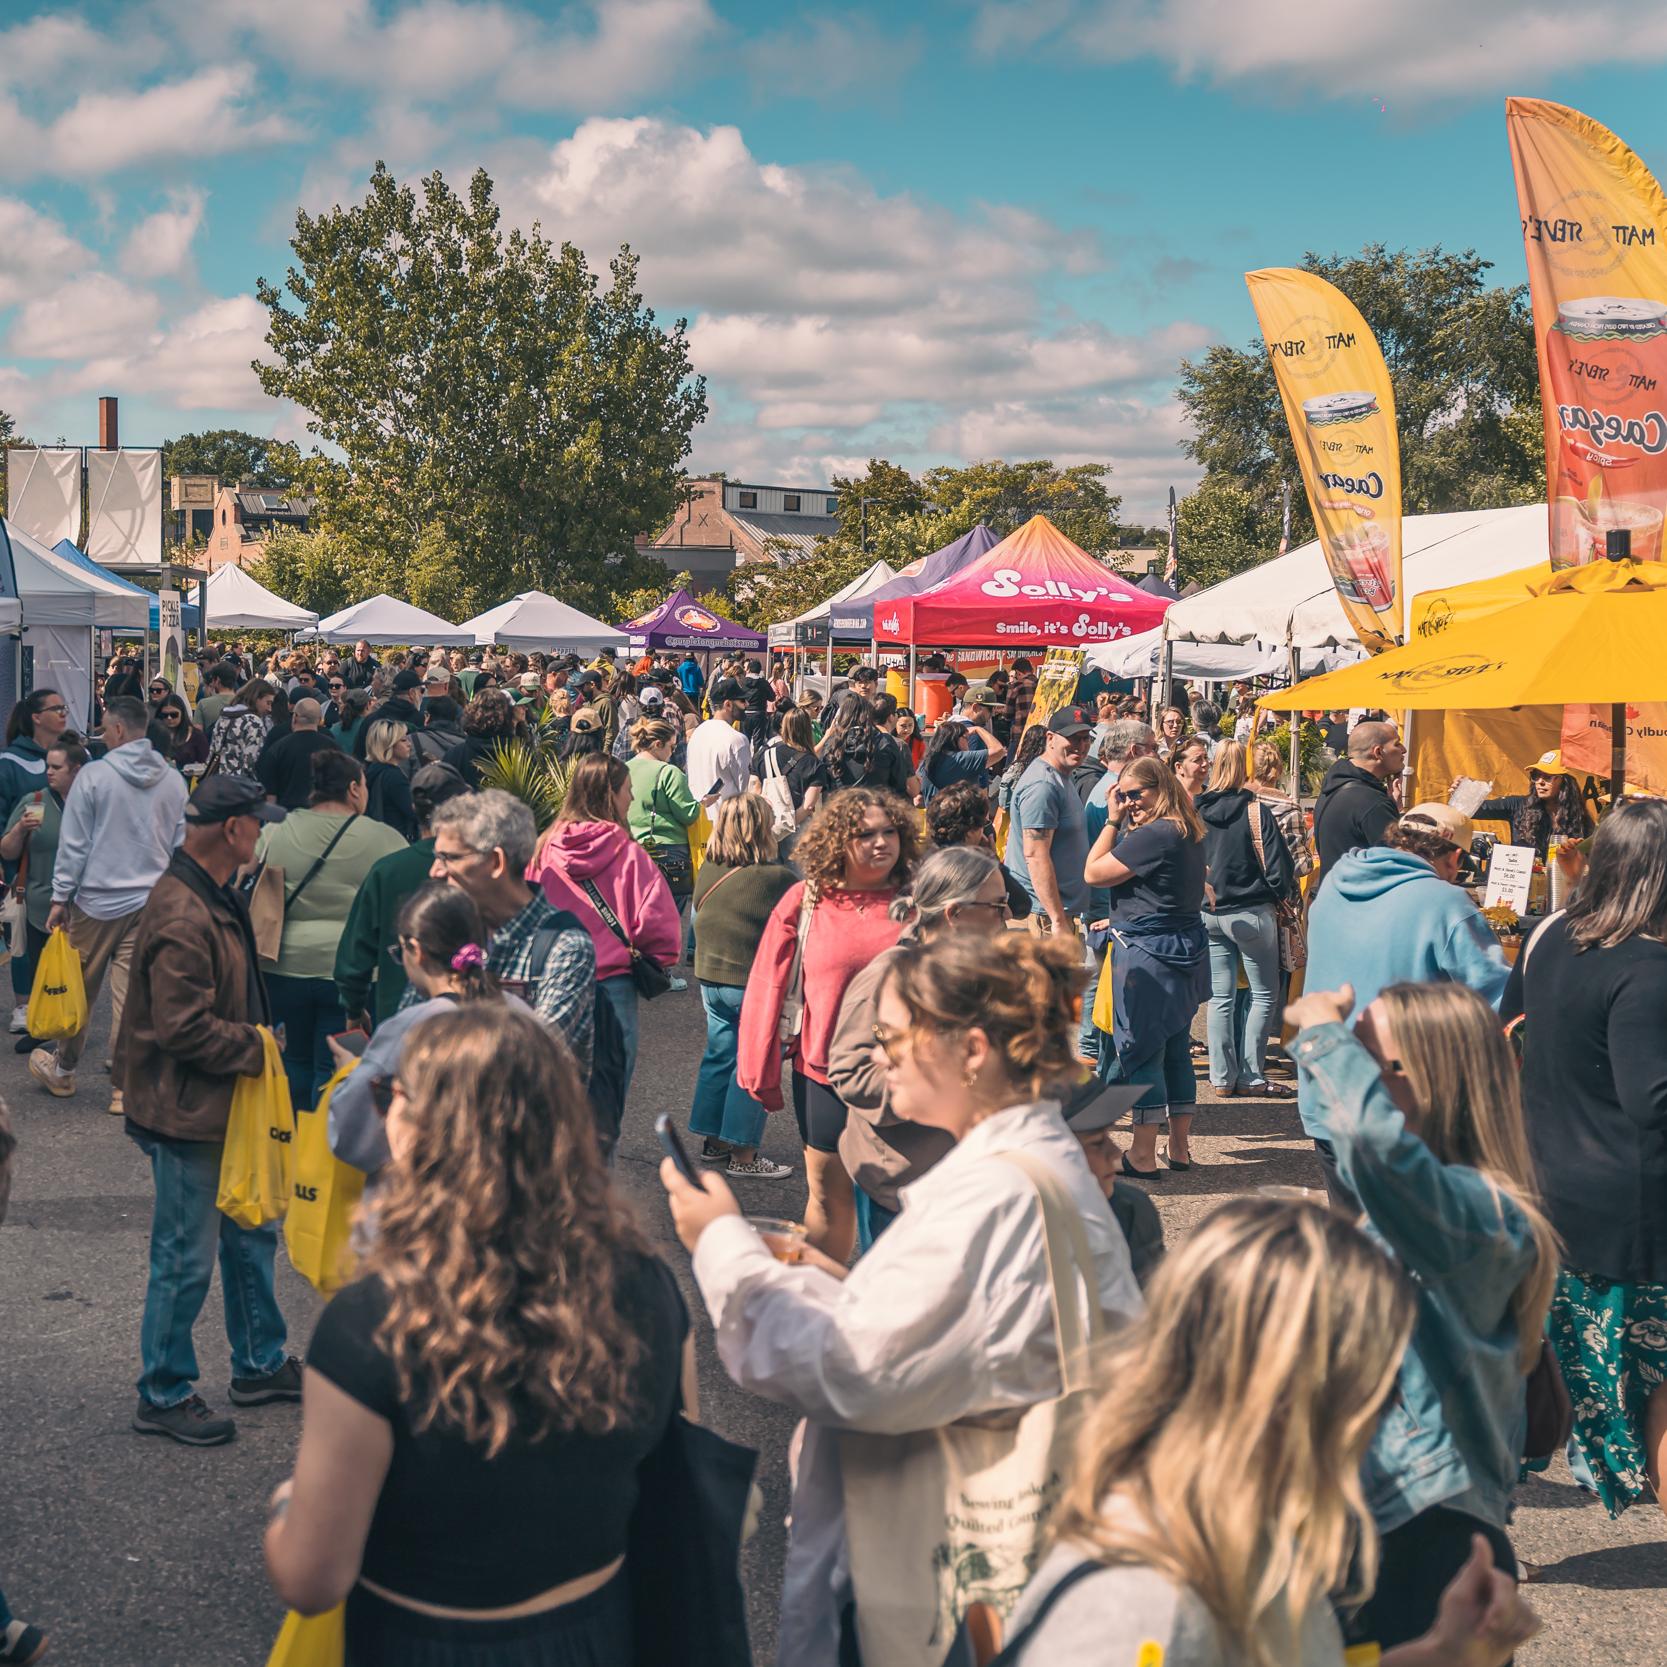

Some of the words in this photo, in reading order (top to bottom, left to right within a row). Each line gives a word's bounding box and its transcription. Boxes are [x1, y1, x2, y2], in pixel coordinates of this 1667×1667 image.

[981, 568, 1134, 603] Solly's
[162, 600, 179, 612] PICKLE
[162, 614, 180, 627] PIZZA
[996, 621, 1042, 636] Smile,
[1044, 621, 1069, 635] it's
[1072, 613, 1132, 640] Solly's
[958, 650, 995, 662] SANDWICH
[600, 906, 617, 927] LOUIS
